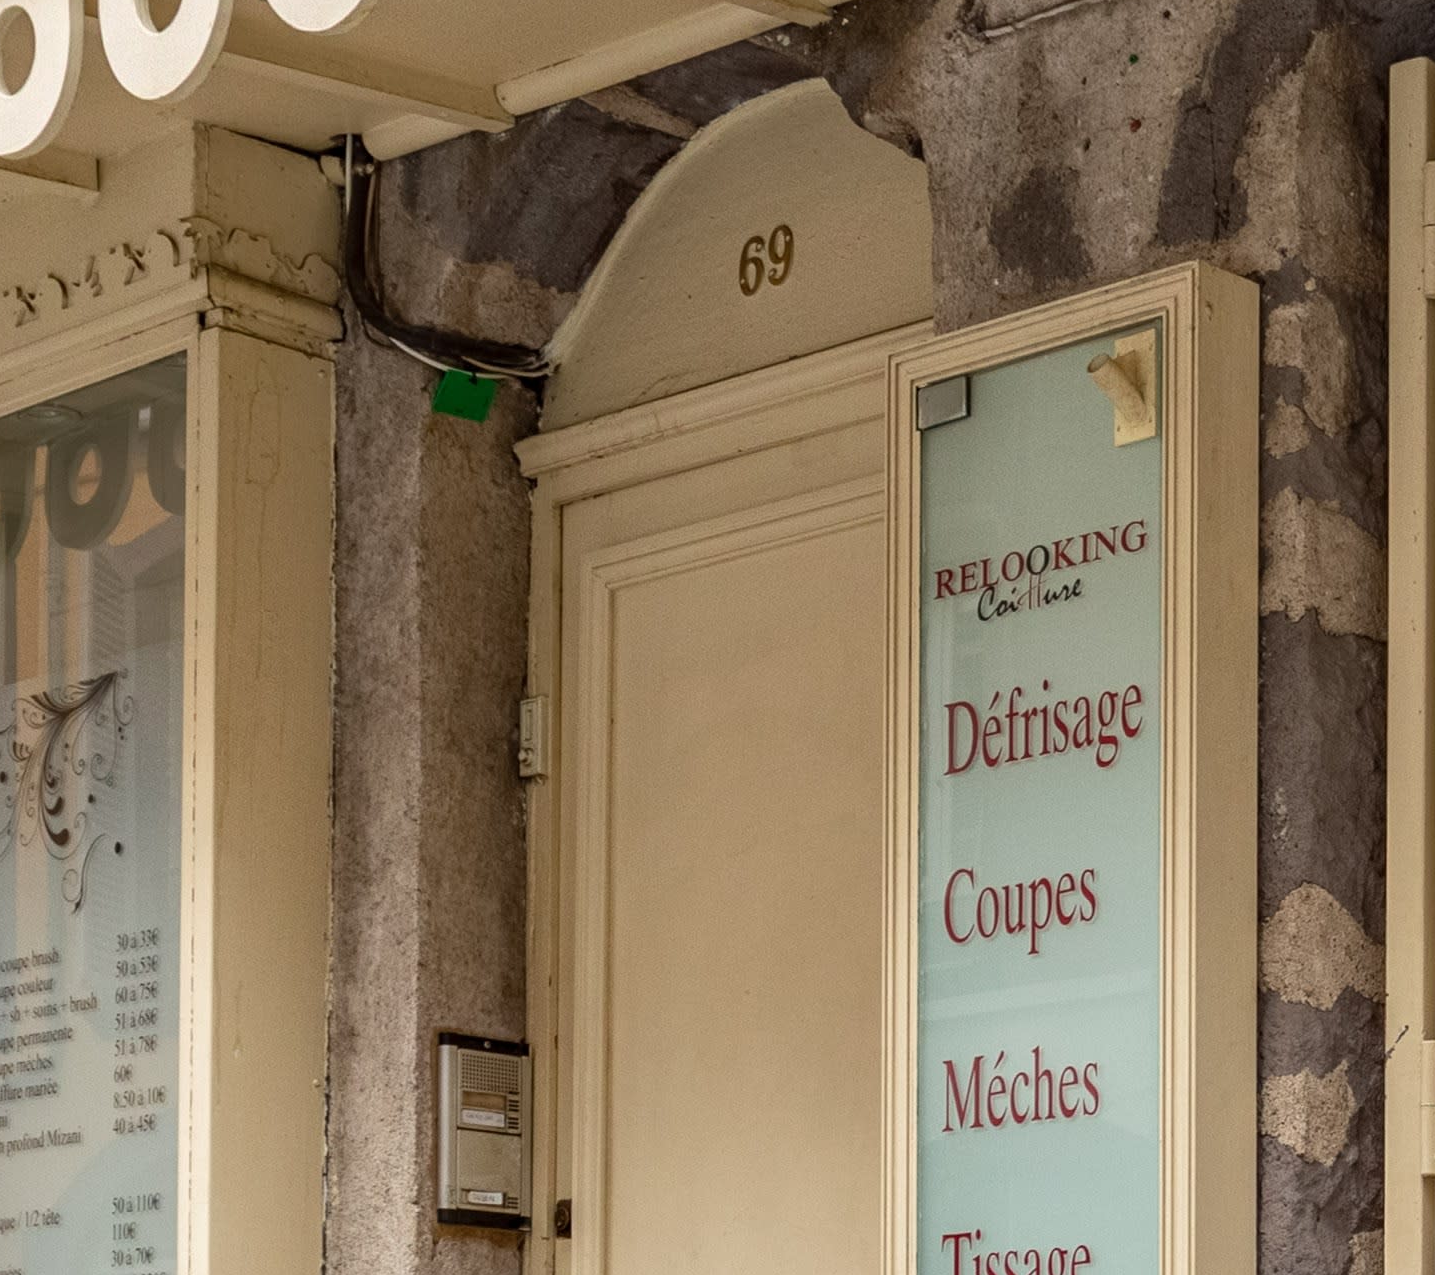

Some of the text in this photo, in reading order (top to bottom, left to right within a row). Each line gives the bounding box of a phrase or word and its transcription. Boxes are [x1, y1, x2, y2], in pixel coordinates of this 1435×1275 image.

[739, 224, 795, 296] 69
[934, 519, 1148, 600] RELOOKING
[944, 679, 1144, 777] Défrisage
[943, 867, 1097, 955] Coupes
[1, 958, 28, 975] coupe
[31, 948, 60, 966] brush
[116, 935, 128, 951] 30
[140, 928, 159, 946] 33€
[18, 977, 54, 995] couleur
[70, 992, 98, 1014] brush
[116, 986, 128, 1004] 60
[139, 981, 158, 1000] 75€
[17, 1026, 74, 1052] permanente
[115, 1014, 126, 1030] 51
[138, 1008, 157, 1025] 68€
[114, 1040, 125, 1057] 51
[138, 1035, 157, 1053] 78€
[114, 1065, 133, 1083] 60€
[942, 1045, 1101, 1133] Méches
[146, 1086, 166, 1104] 10€
[6, 1133, 44, 1156] profond
[47, 1126, 82, 1147] Mizani
[113, 1118, 125, 1135] 40
[137, 1113, 156, 1131] 45€
[111, 1198, 125, 1214] 50
[136, 1192, 161, 1211] 110€
[112, 1222, 136, 1241] 110€
[111, 1250, 124, 1267] 30
[136, 1246, 154, 1265] 70€
